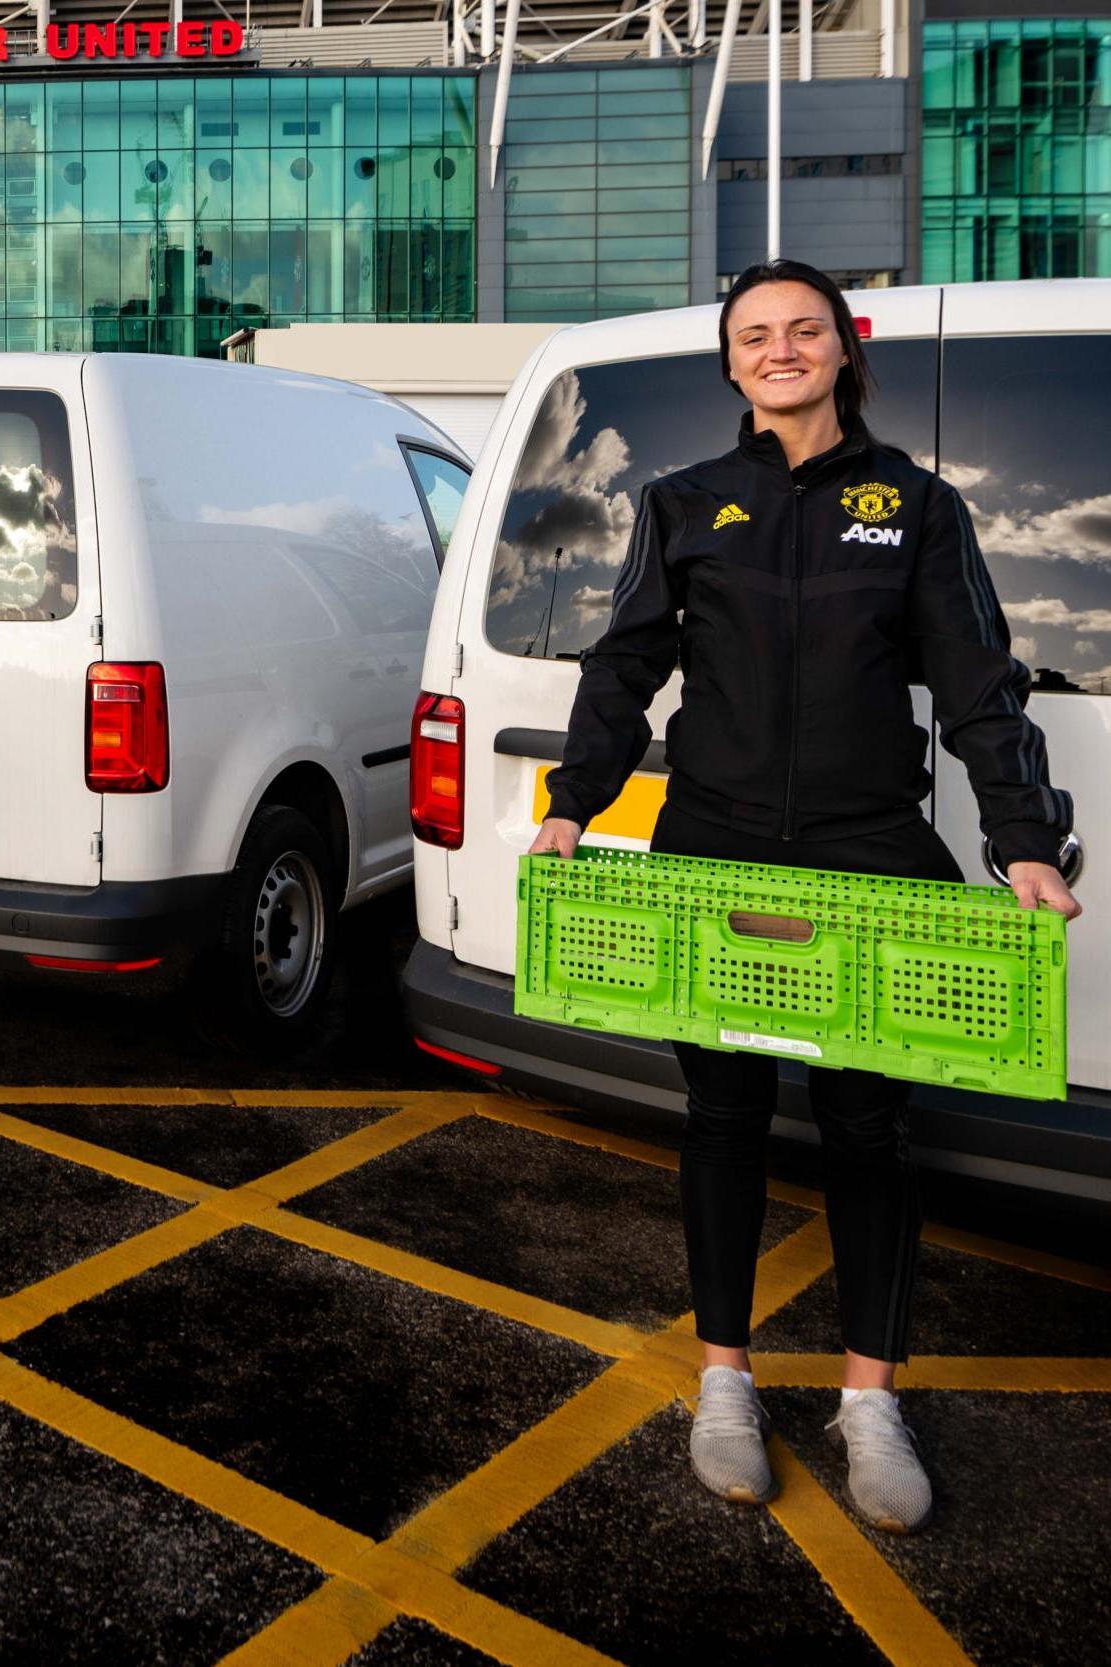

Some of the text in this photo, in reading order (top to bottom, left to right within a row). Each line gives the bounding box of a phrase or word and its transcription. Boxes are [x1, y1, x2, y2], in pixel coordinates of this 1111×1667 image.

[45, 20, 244, 59] UNITED
[847, 484, 895, 498] MANCHESTER
[713, 513, 750, 530] adidas
[854, 511, 889, 521] UNITED
[841, 523, 903, 546] AON
